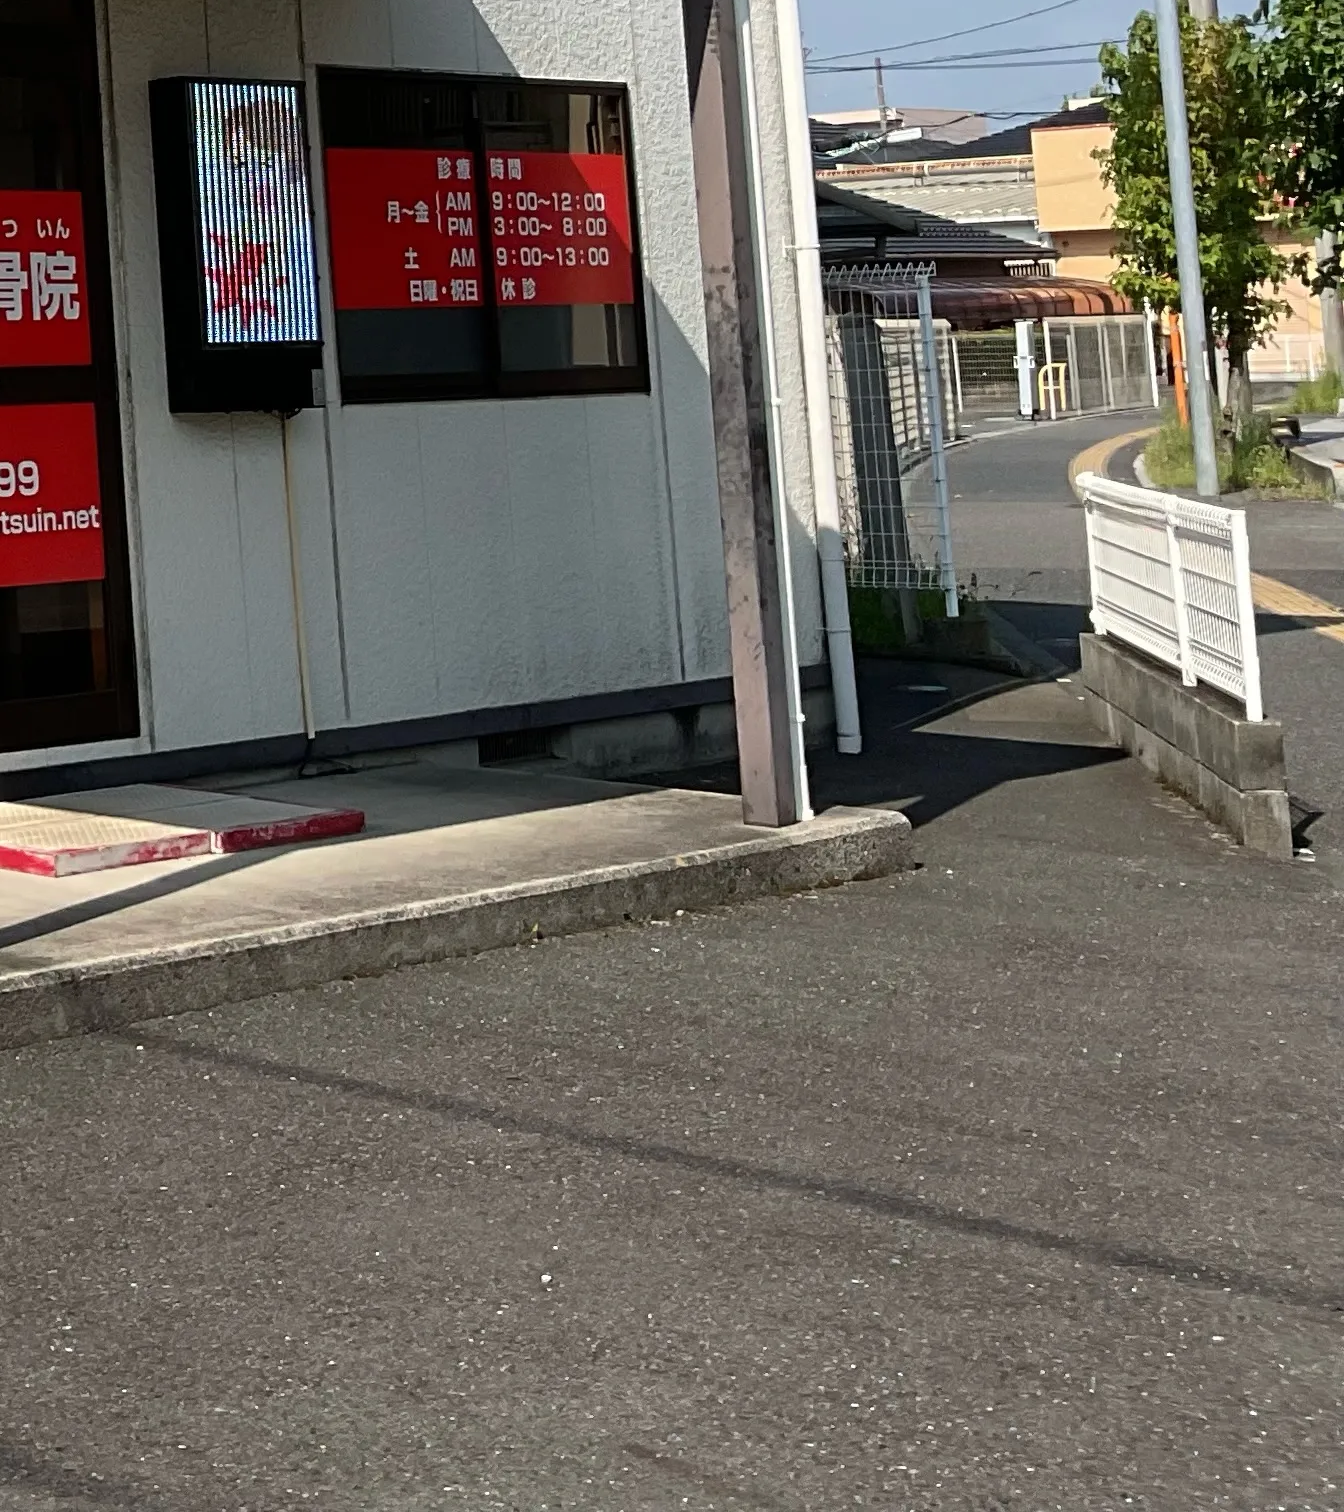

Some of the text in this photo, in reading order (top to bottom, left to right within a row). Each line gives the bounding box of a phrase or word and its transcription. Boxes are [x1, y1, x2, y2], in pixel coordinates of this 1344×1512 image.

[445, 191, 471, 211] AM
[447, 217, 473, 236] PM
[404, 247, 420, 269] 土
[450, 247, 476, 267] AM
